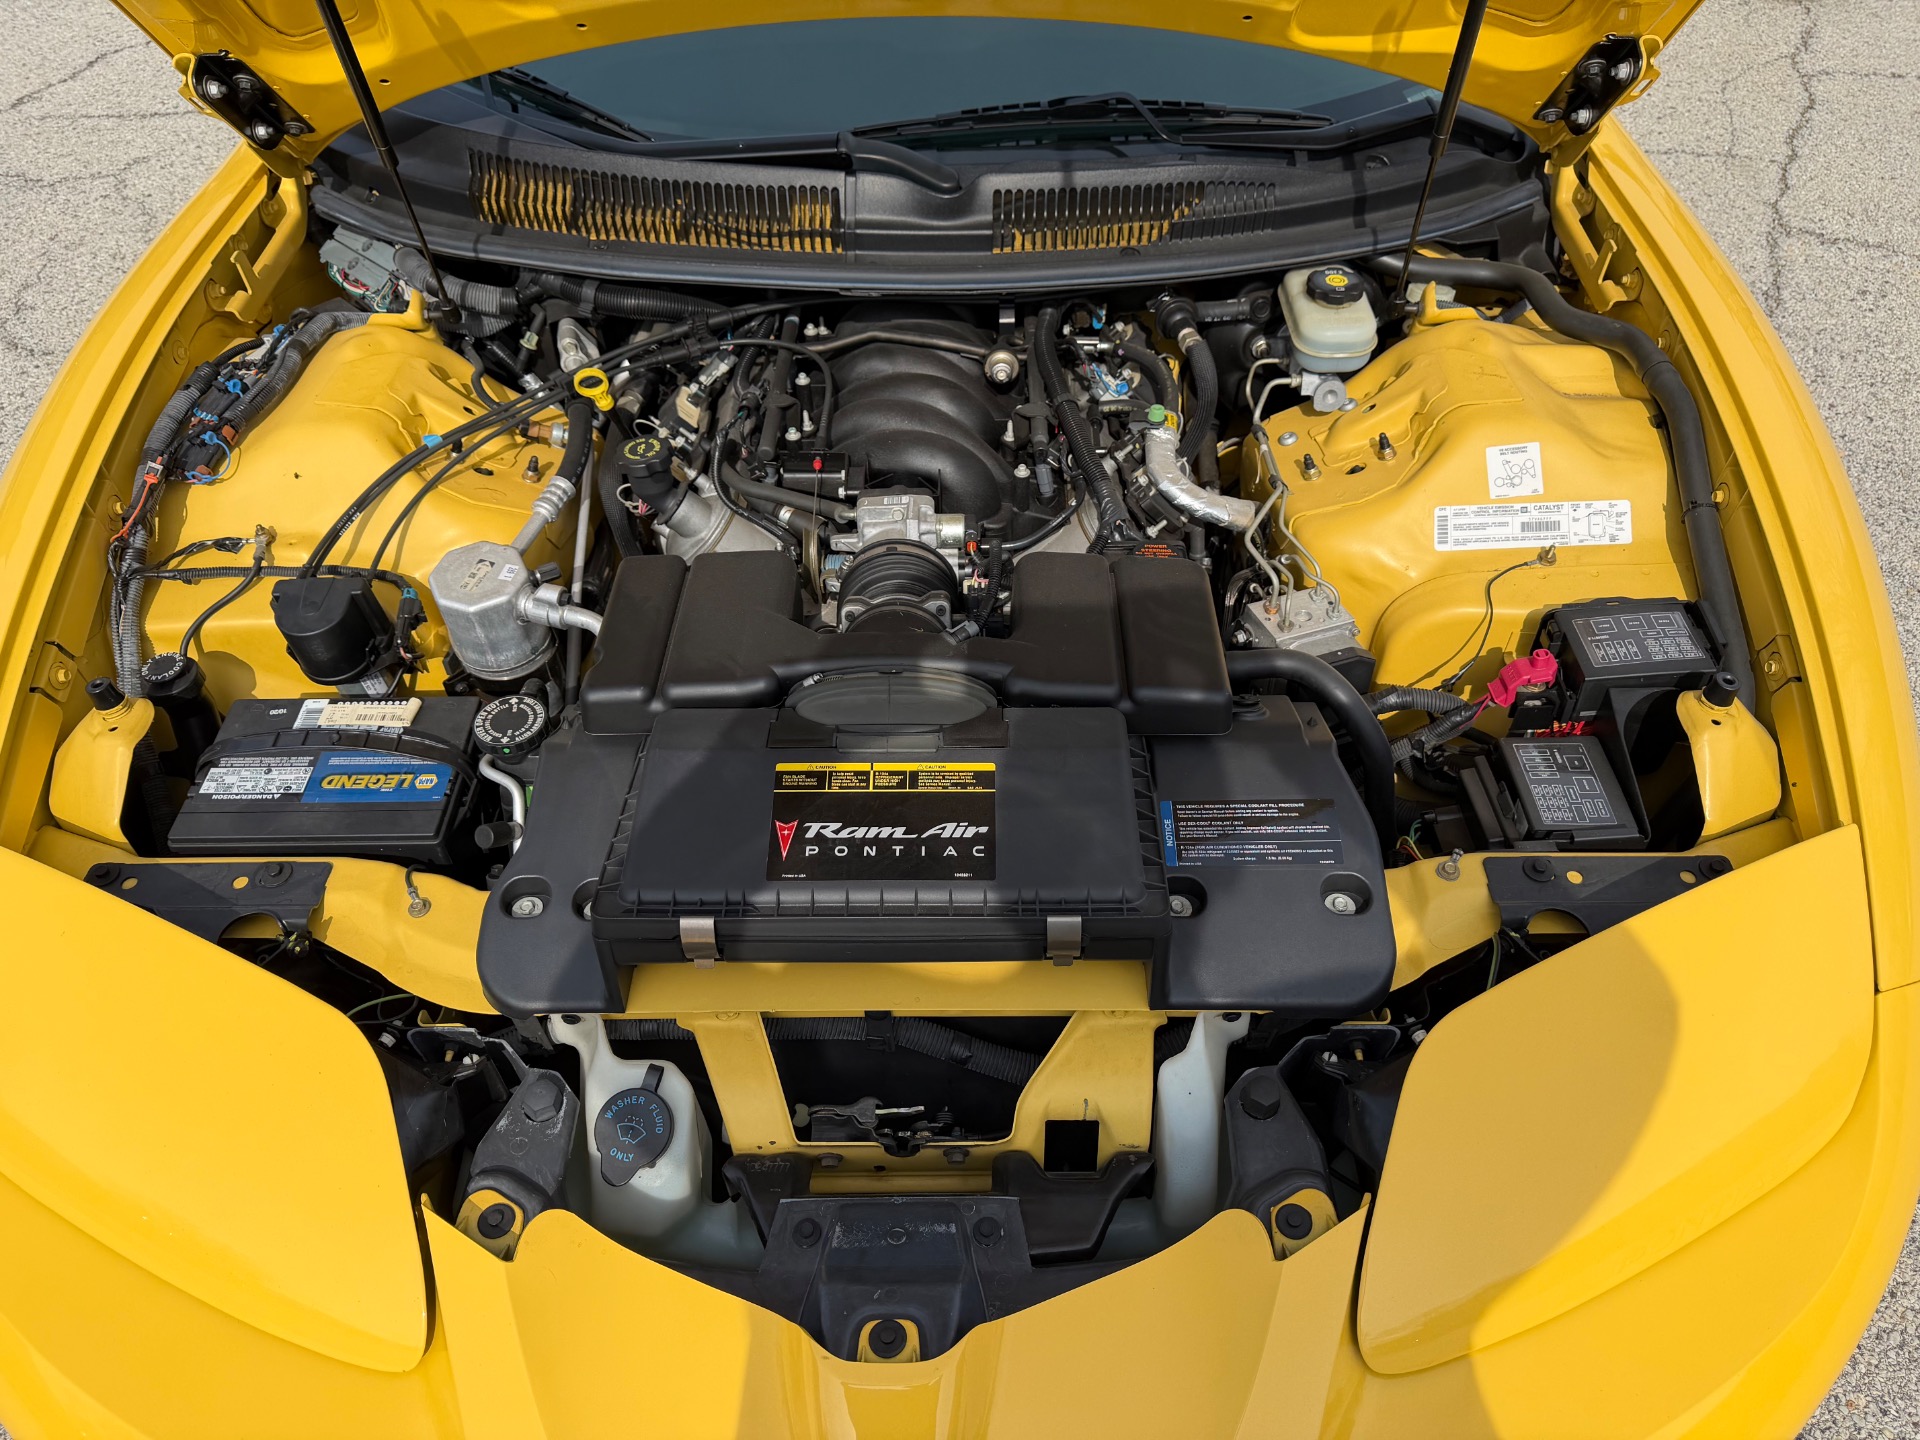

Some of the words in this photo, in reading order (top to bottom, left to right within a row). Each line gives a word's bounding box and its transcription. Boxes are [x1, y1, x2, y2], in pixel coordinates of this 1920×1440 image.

[155, 652, 183, 661] ENGINE
[141, 659, 153, 675] ONLY
[145, 662, 183, 680] COOLANT
[476, 727, 493, 742] NEVER
[486, 701, 500, 712] HOT
[321, 774, 414, 788] LEGEND
[419, 777, 435, 785] NAPA
[803, 822, 918, 839] Ram
[921, 822, 989, 839] Air
[1164, 819, 1173, 847] NOTICE
[805, 846, 985, 857] PONTIAC
[605, 1095, 646, 1119] WASHER
[649, 1103, 664, 1134] FLUID
[610, 1147, 635, 1162] ONLY
